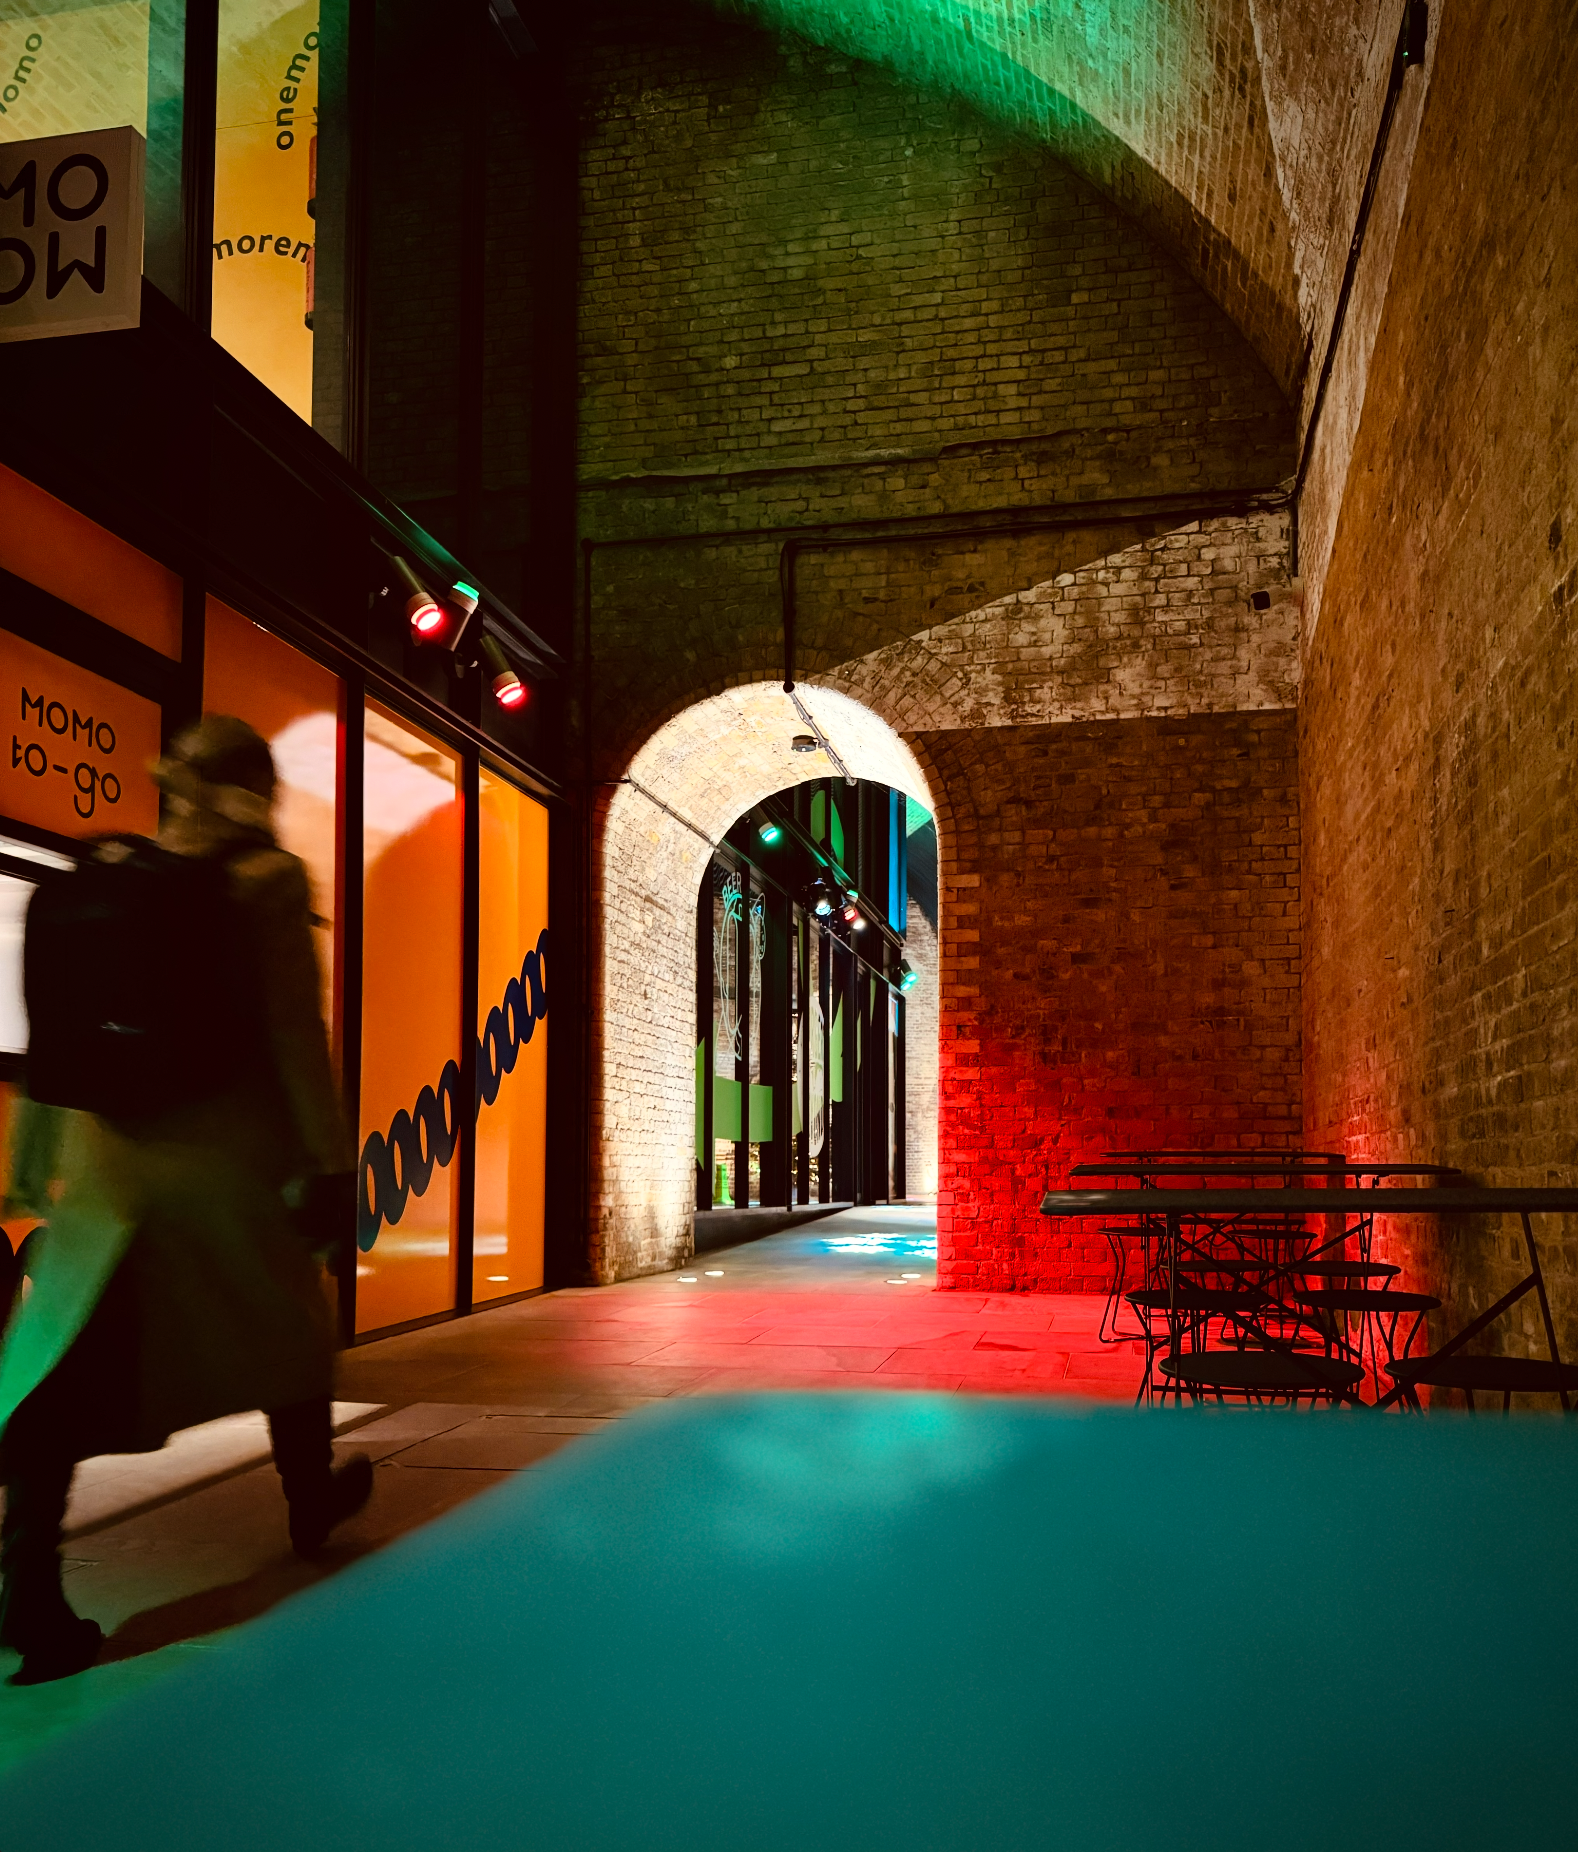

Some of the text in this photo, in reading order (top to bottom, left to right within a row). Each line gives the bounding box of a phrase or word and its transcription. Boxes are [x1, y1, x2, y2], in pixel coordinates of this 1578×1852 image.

[276, 22, 319, 150] onemo
[21, 686, 116, 754] MOMO
[12, 735, 121, 818] to-go
